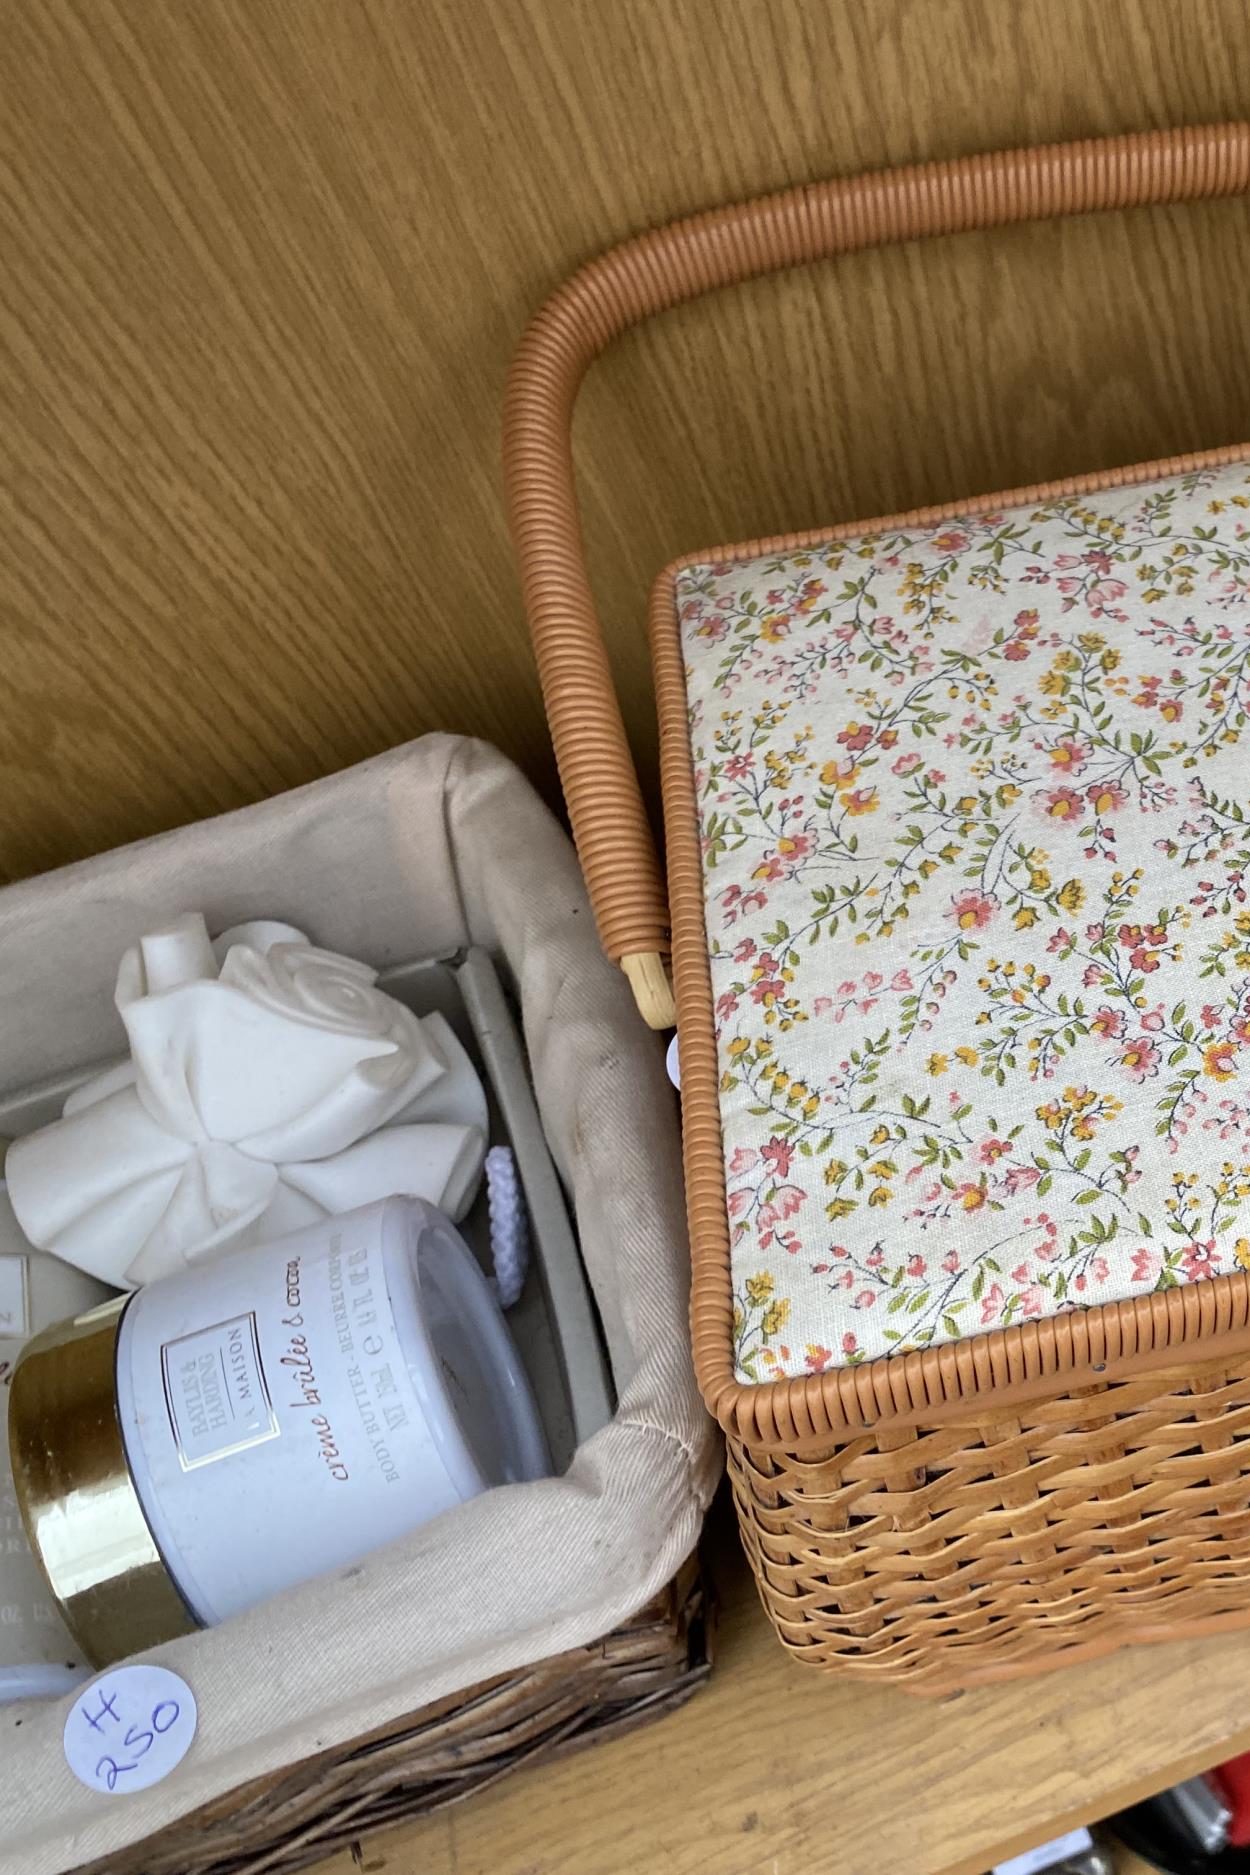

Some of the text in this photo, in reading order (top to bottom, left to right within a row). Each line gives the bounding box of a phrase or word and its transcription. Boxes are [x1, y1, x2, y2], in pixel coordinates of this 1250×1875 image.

[331, 1291, 355, 1353] BEURRE
[180, 1357, 210, 1438] BAYLIS &
[199, 1352, 228, 1431] HARDING
[228, 1327, 252, 1400] MAISON
[280, 1333, 322, 1408] brûlée
[347, 1364, 381, 1436] BUTTER
[311, 1413, 349, 1481] crème
[370, 1439, 401, 1483] BODY
[82, 1689, 121, 1734] H
